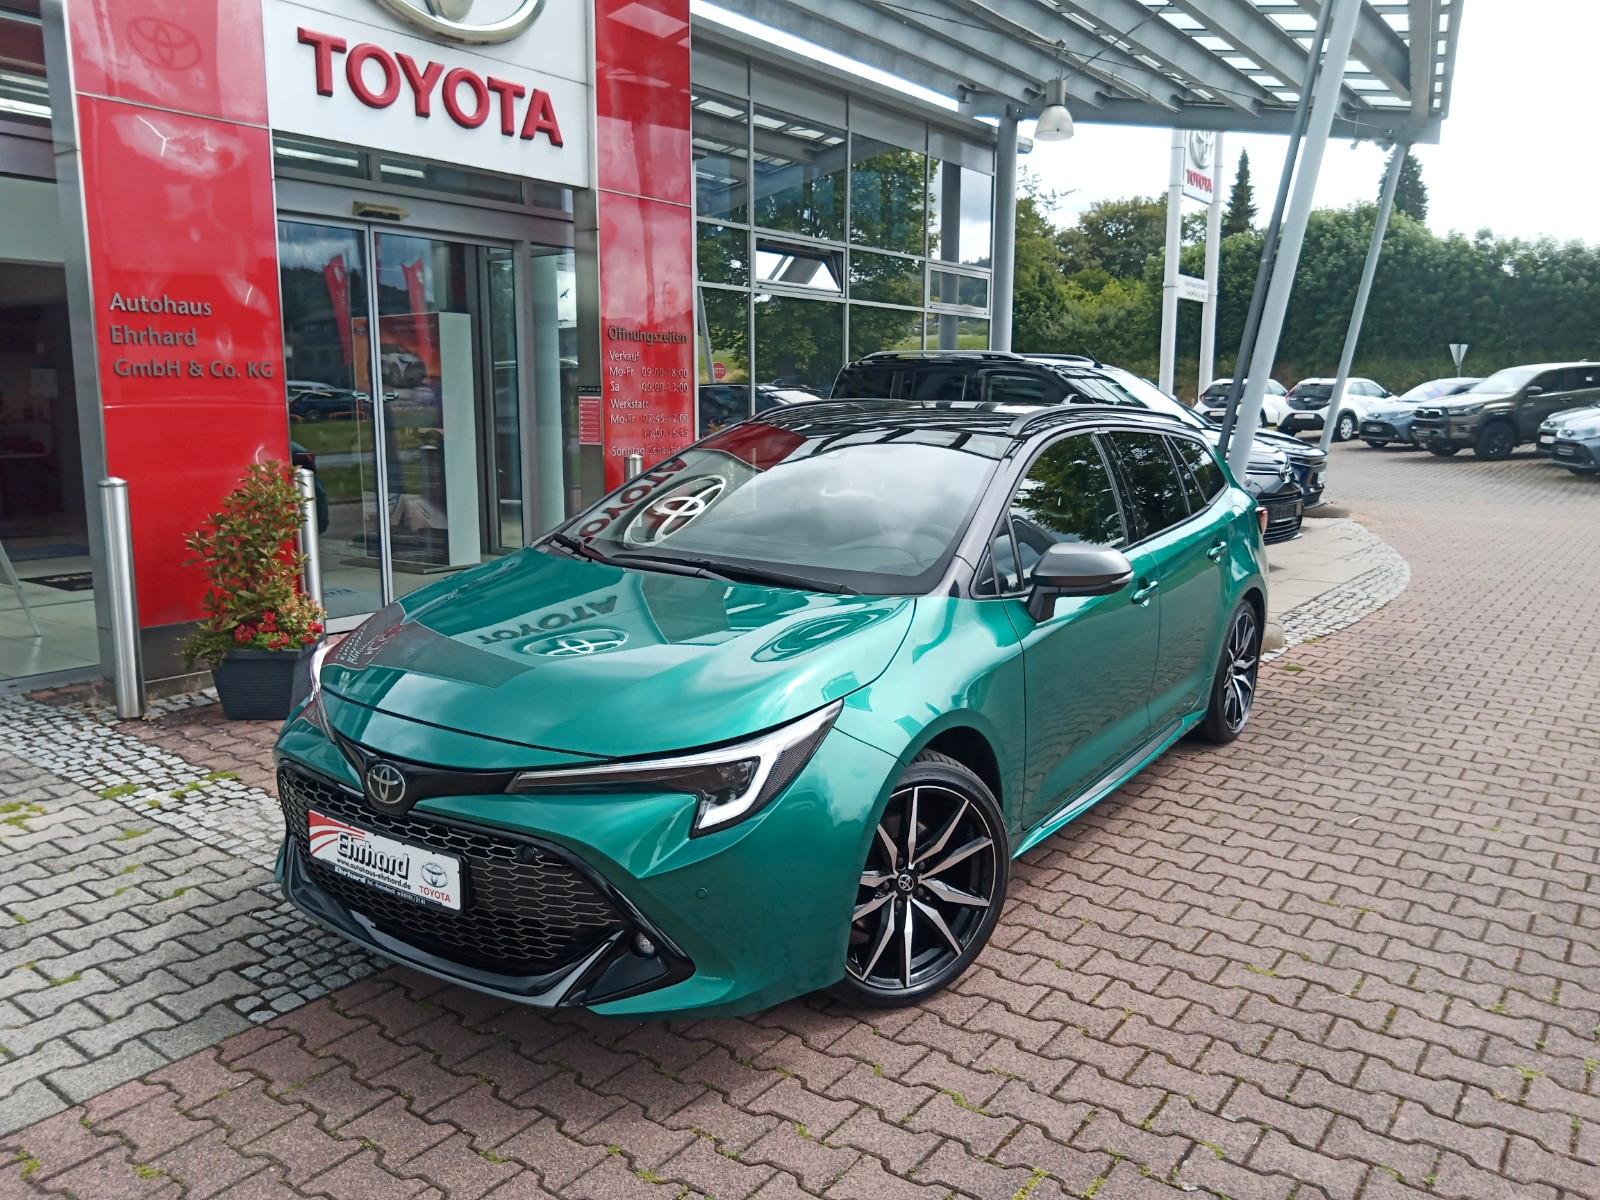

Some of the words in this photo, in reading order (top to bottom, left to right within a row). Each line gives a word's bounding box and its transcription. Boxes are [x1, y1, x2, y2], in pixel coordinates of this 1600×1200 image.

[298, 26, 564, 148] TOYOTA
[1186, 168, 1212, 193] TOYOTA
[110, 292, 213, 316] Autohaus
[110, 325, 198, 346] Ehrhard
[608, 325, 688, 346] Öffnungszeiten
[609, 349, 640, 362] Verkauf
[114, 358, 182, 377] GmbH
[189, 360, 203, 377] &
[210, 360, 241, 377] Co.
[247, 362, 274, 378] KG
[609, 366, 634, 377] Mo-Fr
[610, 381, 620, 392] Sa
[610, 399, 648, 409] Werkstatt
[337, 831, 410, 880] Ehrhard
[419, 885, 451, 903] TOYOTA
